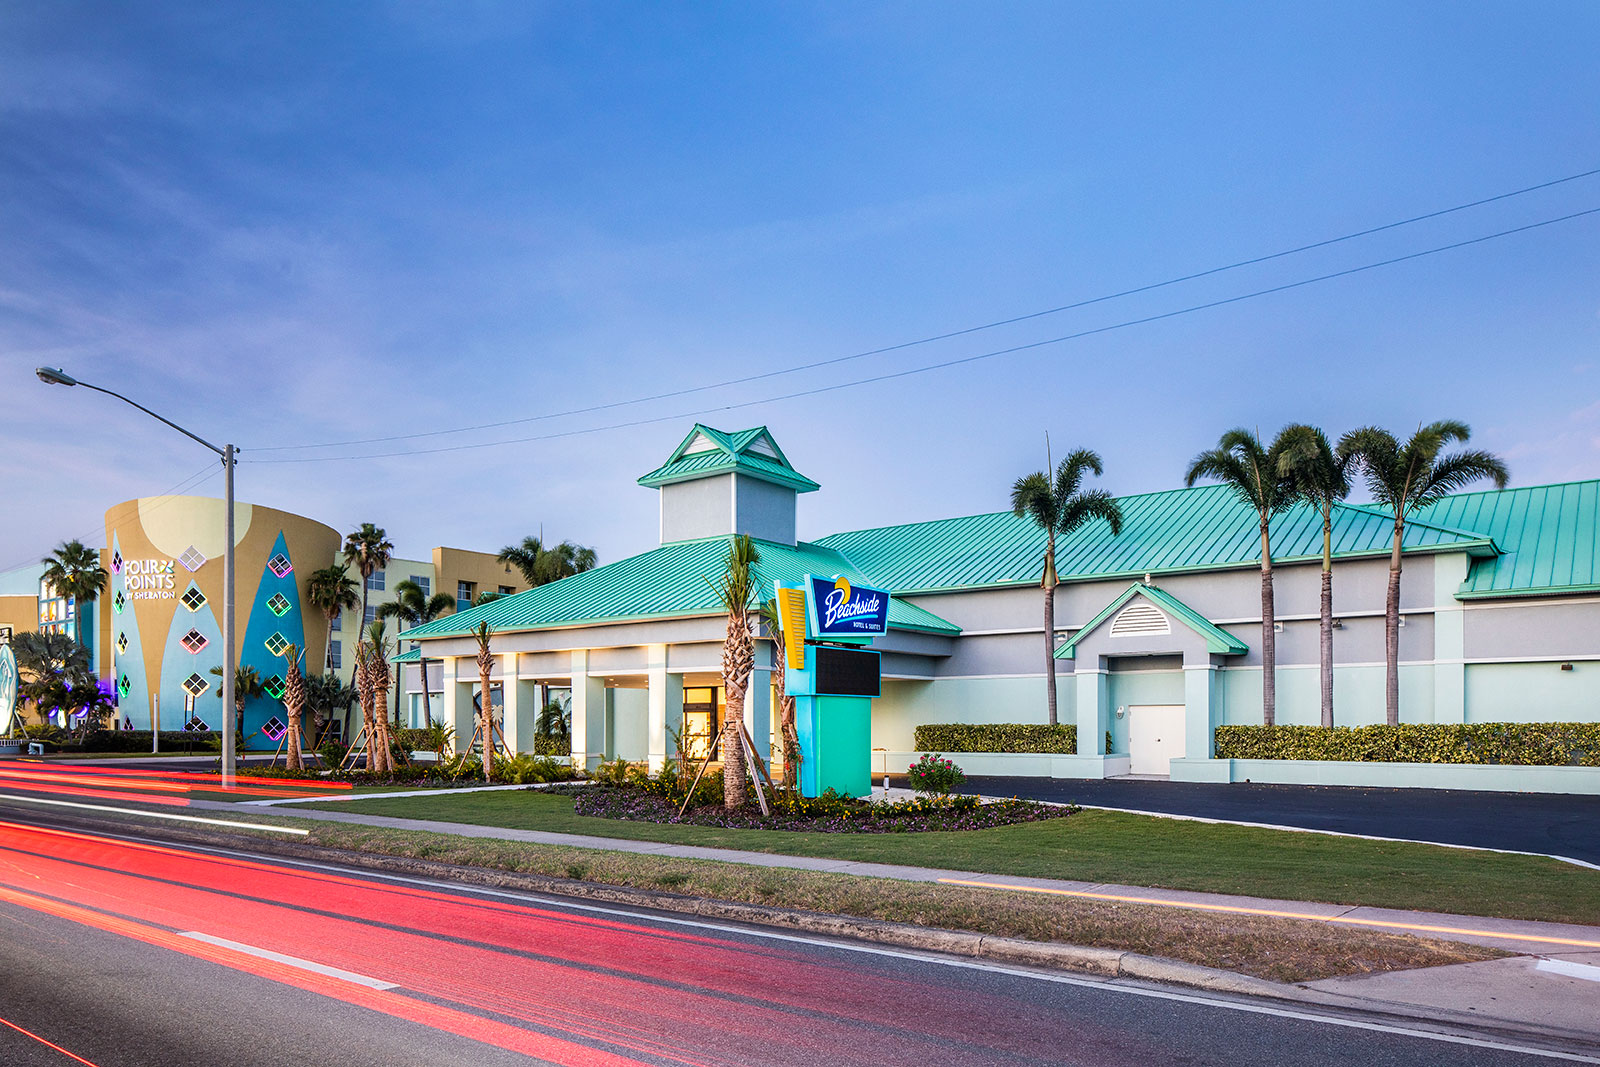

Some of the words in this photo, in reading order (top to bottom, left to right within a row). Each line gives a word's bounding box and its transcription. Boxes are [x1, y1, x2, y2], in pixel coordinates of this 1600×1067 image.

[124, 560, 160, 574] FOUR
[124, 574, 175, 589] POINTS
[126, 592, 133, 600] BY
[134, 591, 175, 600] SHERATON
[825, 588, 879, 628] Beachside
